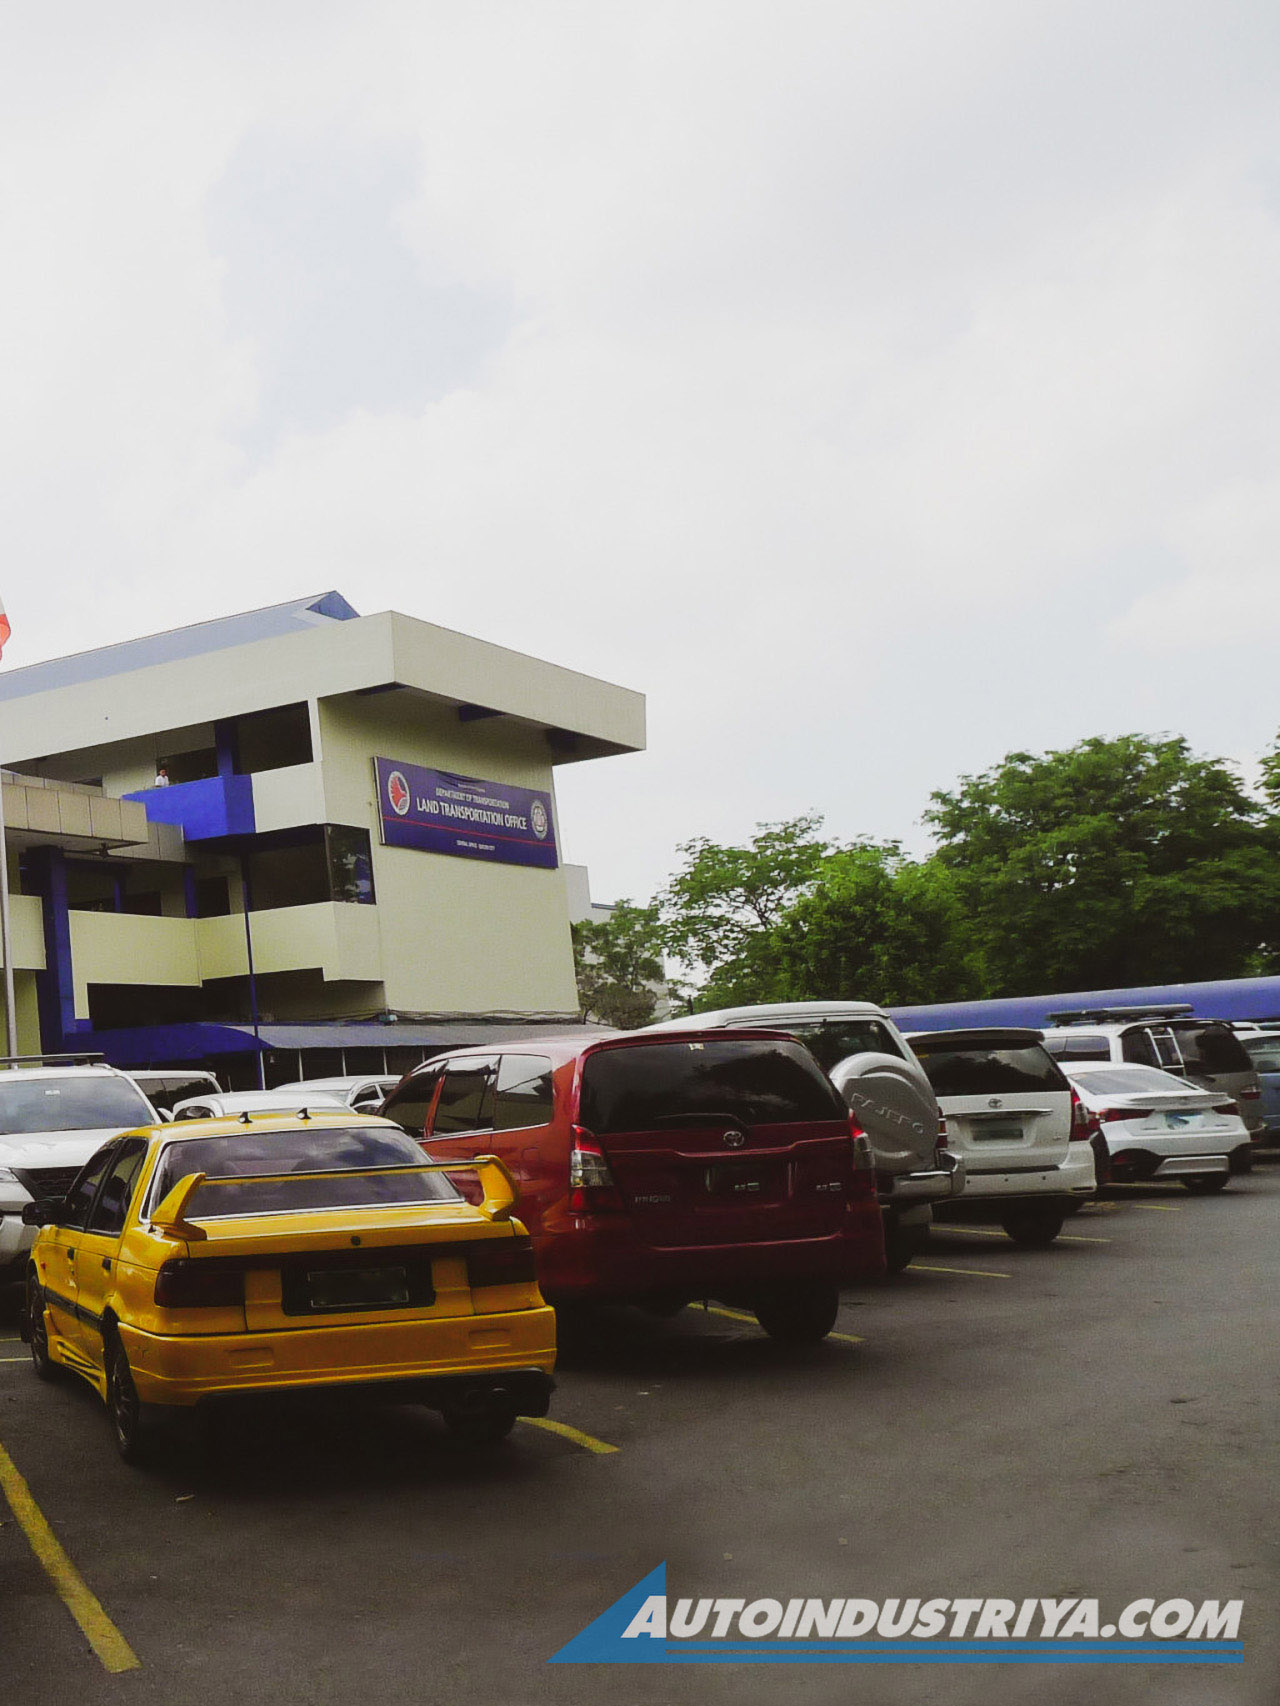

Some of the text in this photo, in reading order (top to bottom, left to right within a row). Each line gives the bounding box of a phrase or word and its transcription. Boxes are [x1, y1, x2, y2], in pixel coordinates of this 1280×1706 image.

[416, 797, 528, 831] LAND TRANSPORTATION OFFICE
